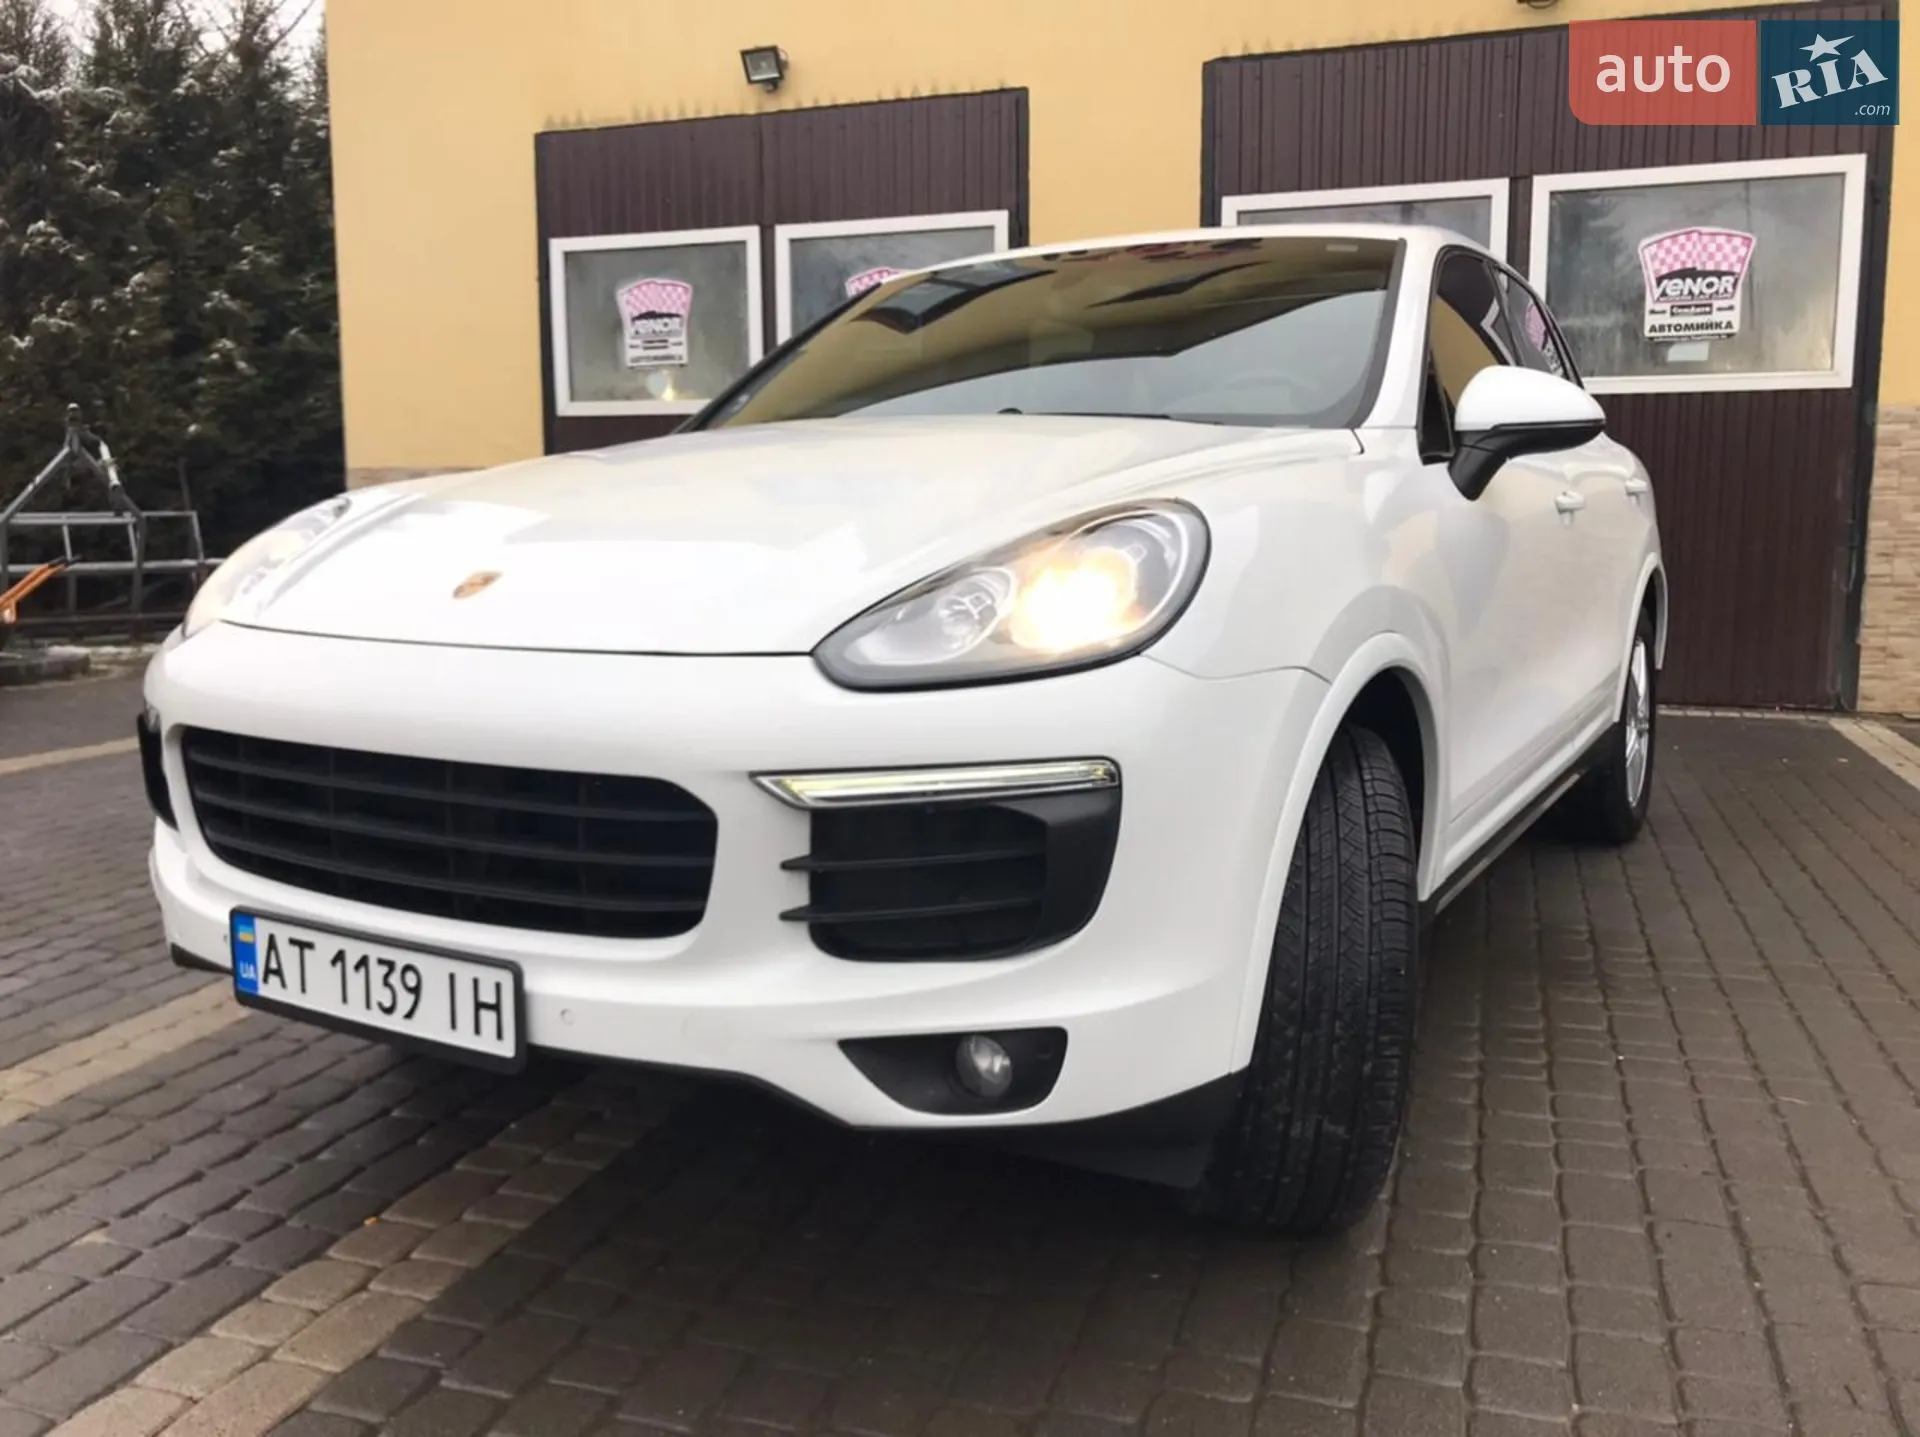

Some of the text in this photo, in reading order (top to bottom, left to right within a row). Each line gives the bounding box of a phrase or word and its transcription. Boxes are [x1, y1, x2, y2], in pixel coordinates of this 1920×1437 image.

[1649, 320, 1734, 333] АВТОМИЙКА
[239, 961, 256, 981] UA
[262, 932, 504, 1041] AT 1139 IH
